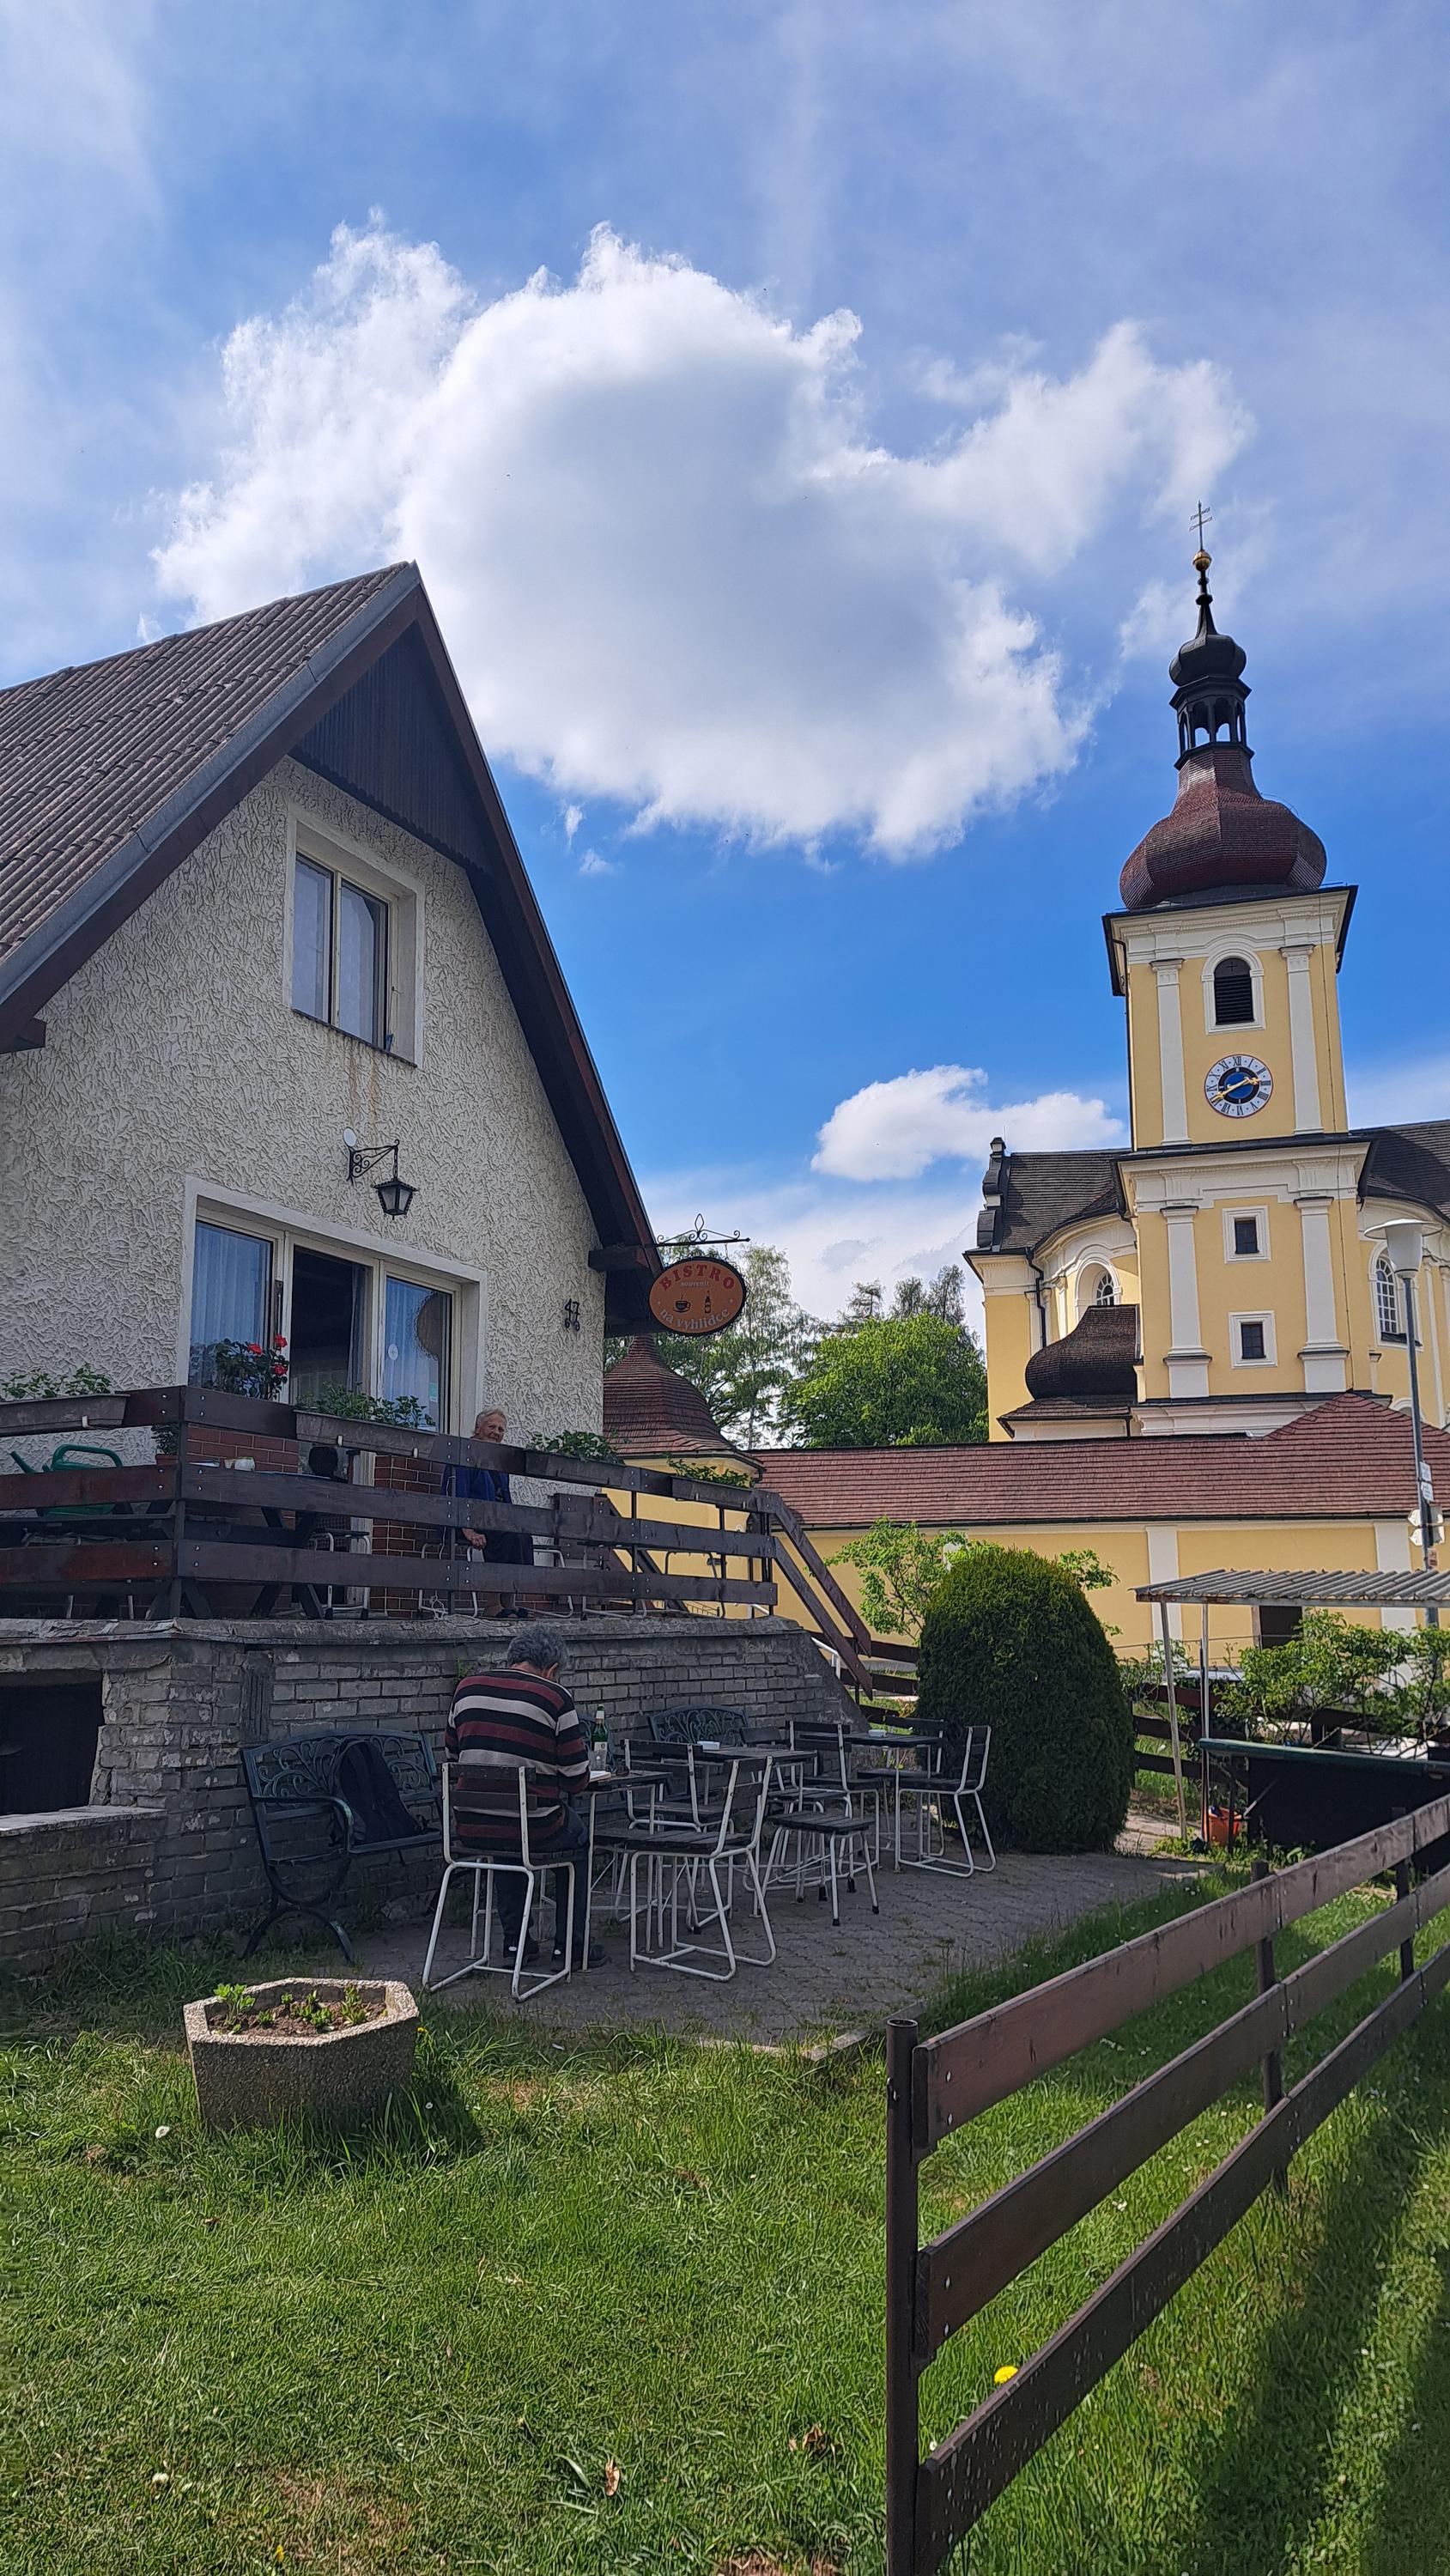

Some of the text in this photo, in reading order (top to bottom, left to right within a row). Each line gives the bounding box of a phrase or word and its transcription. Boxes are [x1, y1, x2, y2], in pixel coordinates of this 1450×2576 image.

[658, 1264, 735, 1291] BISTRO
[564, 1297, 580, 1332] 47
[659, 1309, 674, 1323] na
